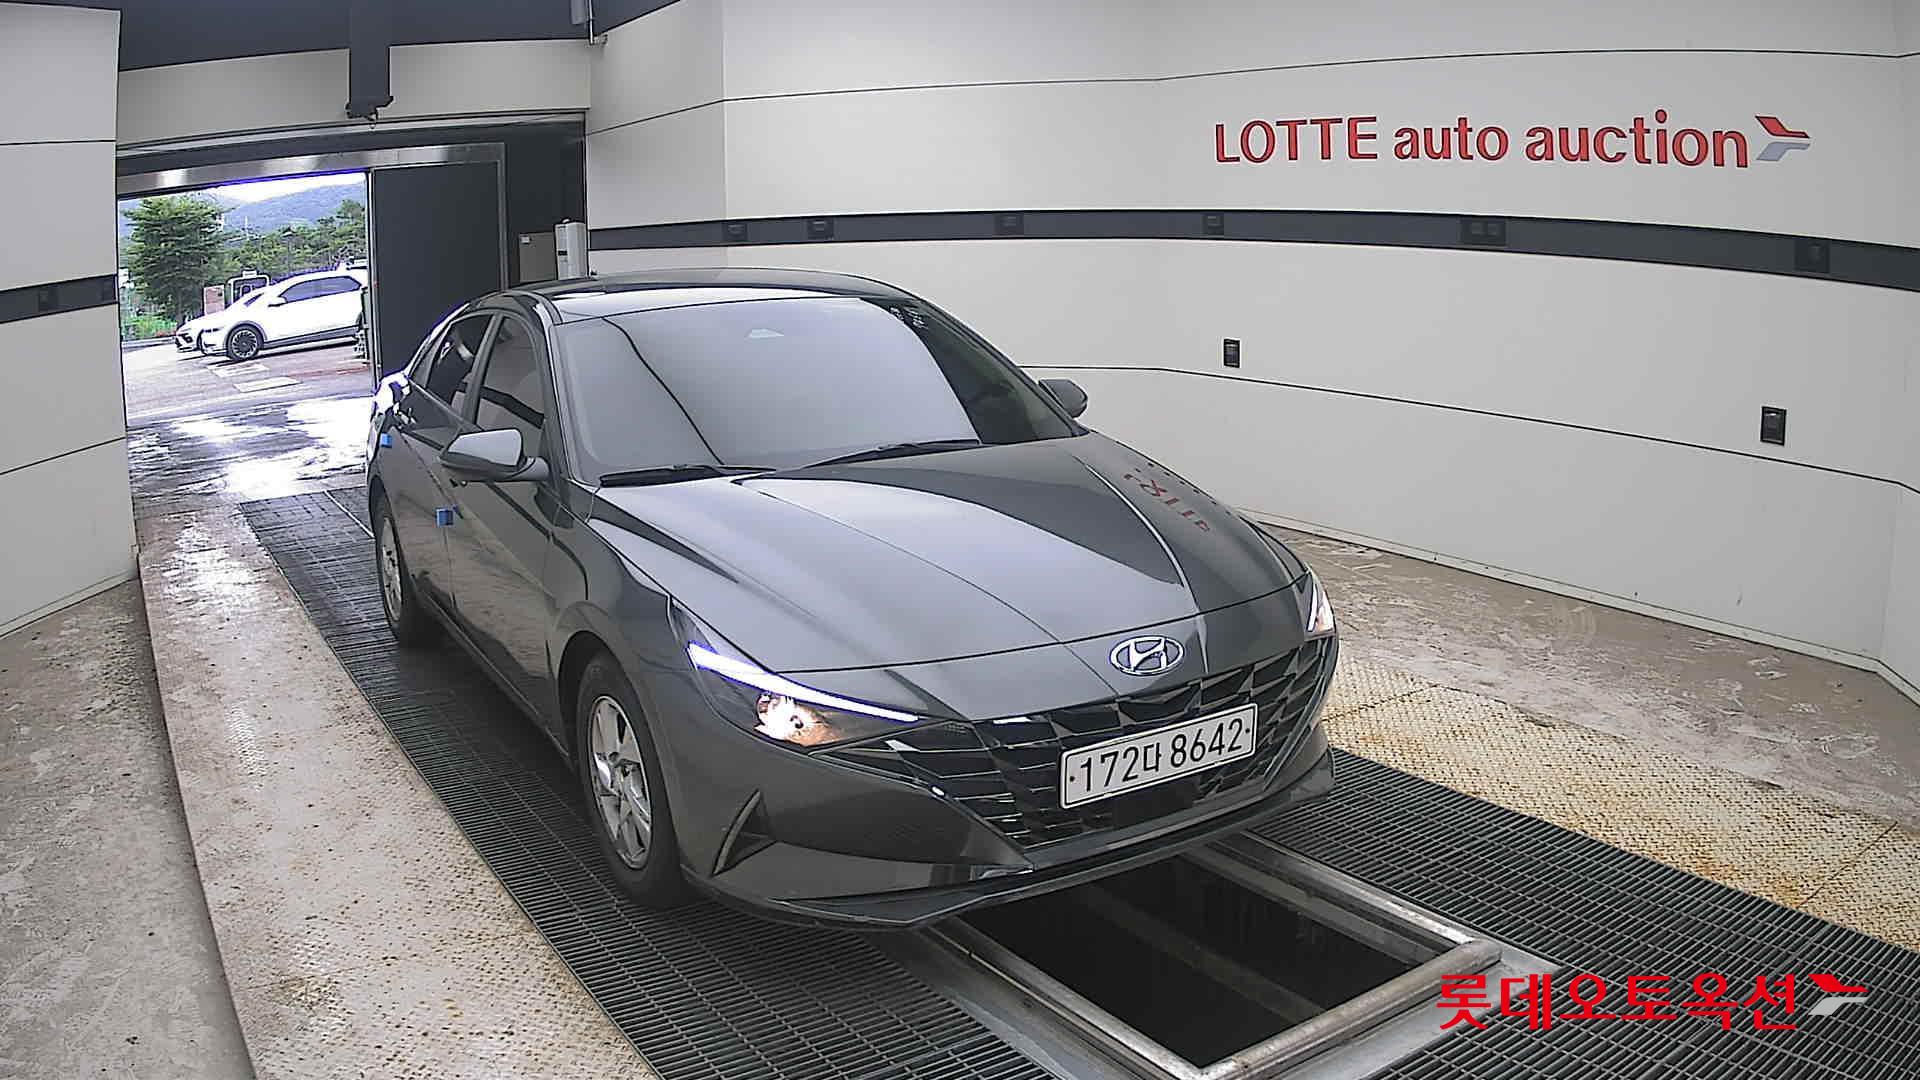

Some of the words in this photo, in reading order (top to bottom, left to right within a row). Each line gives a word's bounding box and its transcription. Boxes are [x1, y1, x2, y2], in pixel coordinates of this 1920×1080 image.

[1215, 115, 1378, 163] LOTTE
[1393, 116, 1510, 162] auto
[1525, 109, 1749, 169] auction
[1170, 718, 1243, 768] 8642
